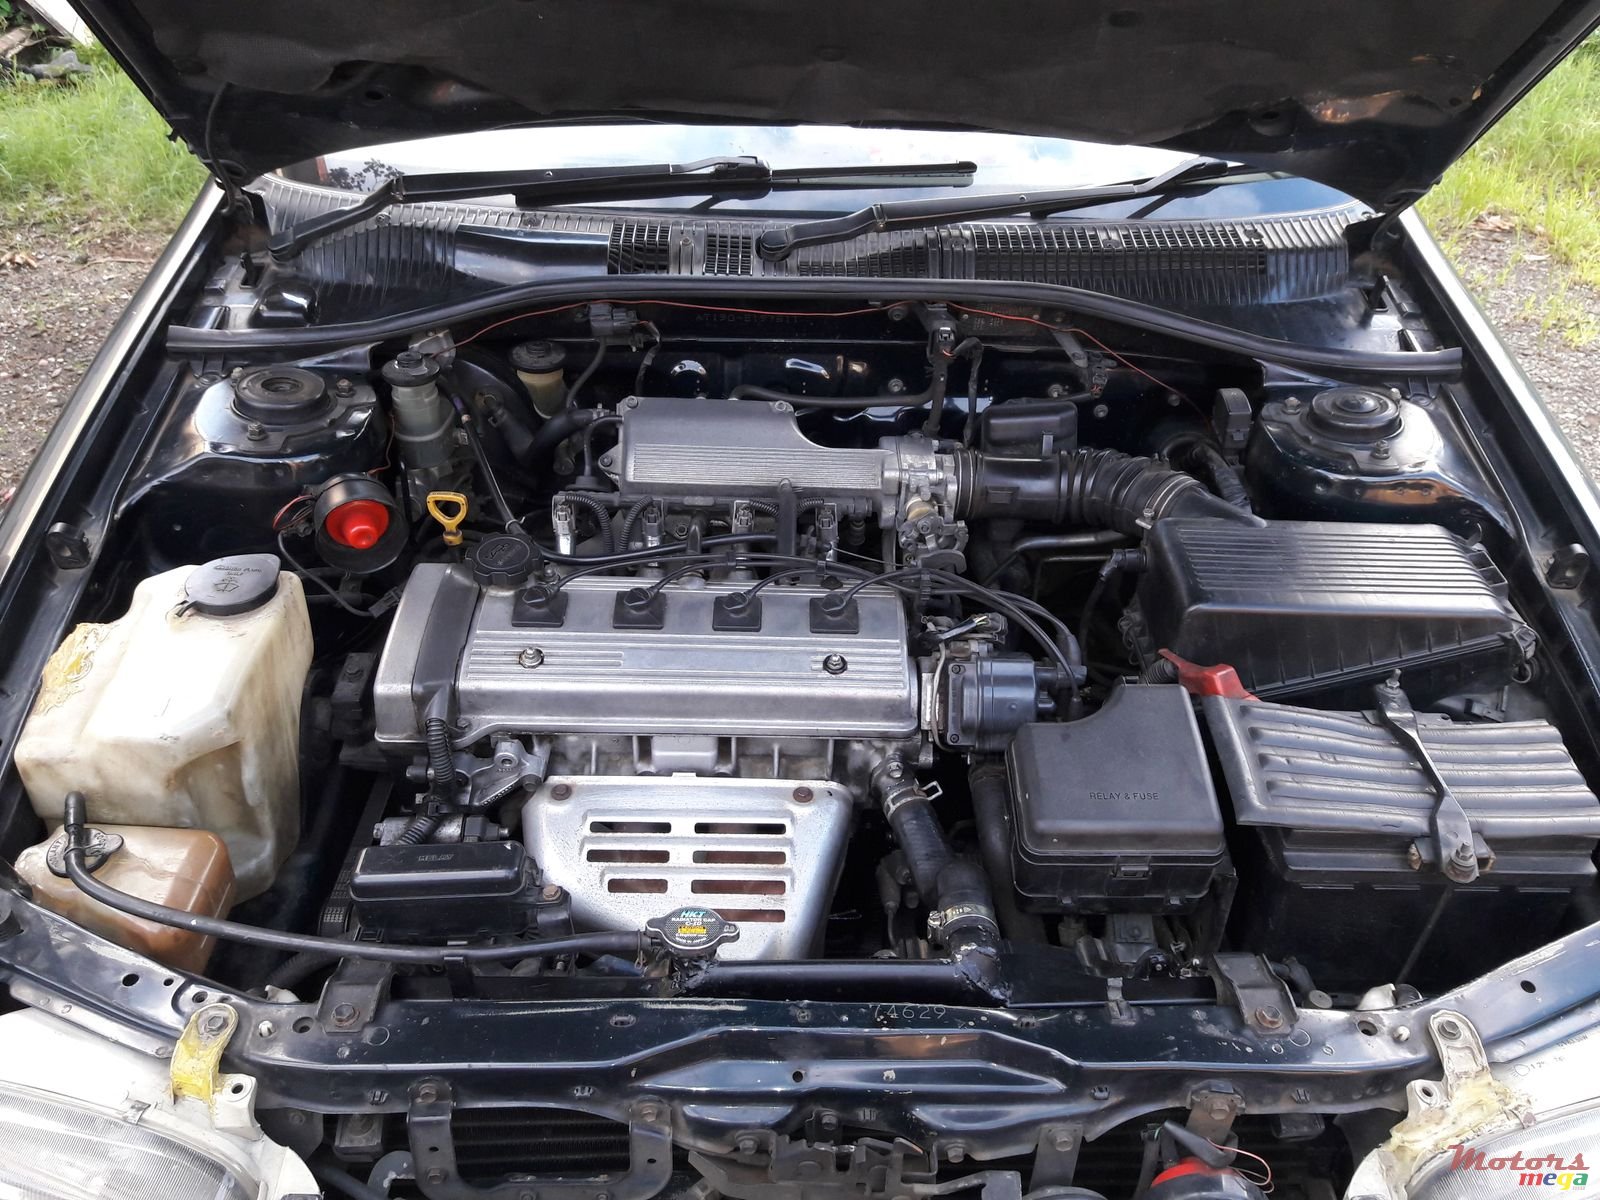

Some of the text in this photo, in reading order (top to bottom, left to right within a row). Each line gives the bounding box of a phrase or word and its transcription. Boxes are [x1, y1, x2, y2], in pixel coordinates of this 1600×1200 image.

[1089, 792, 1159, 800] RELAY & FUSE
[868, 1004, 947, 1019] 74629
